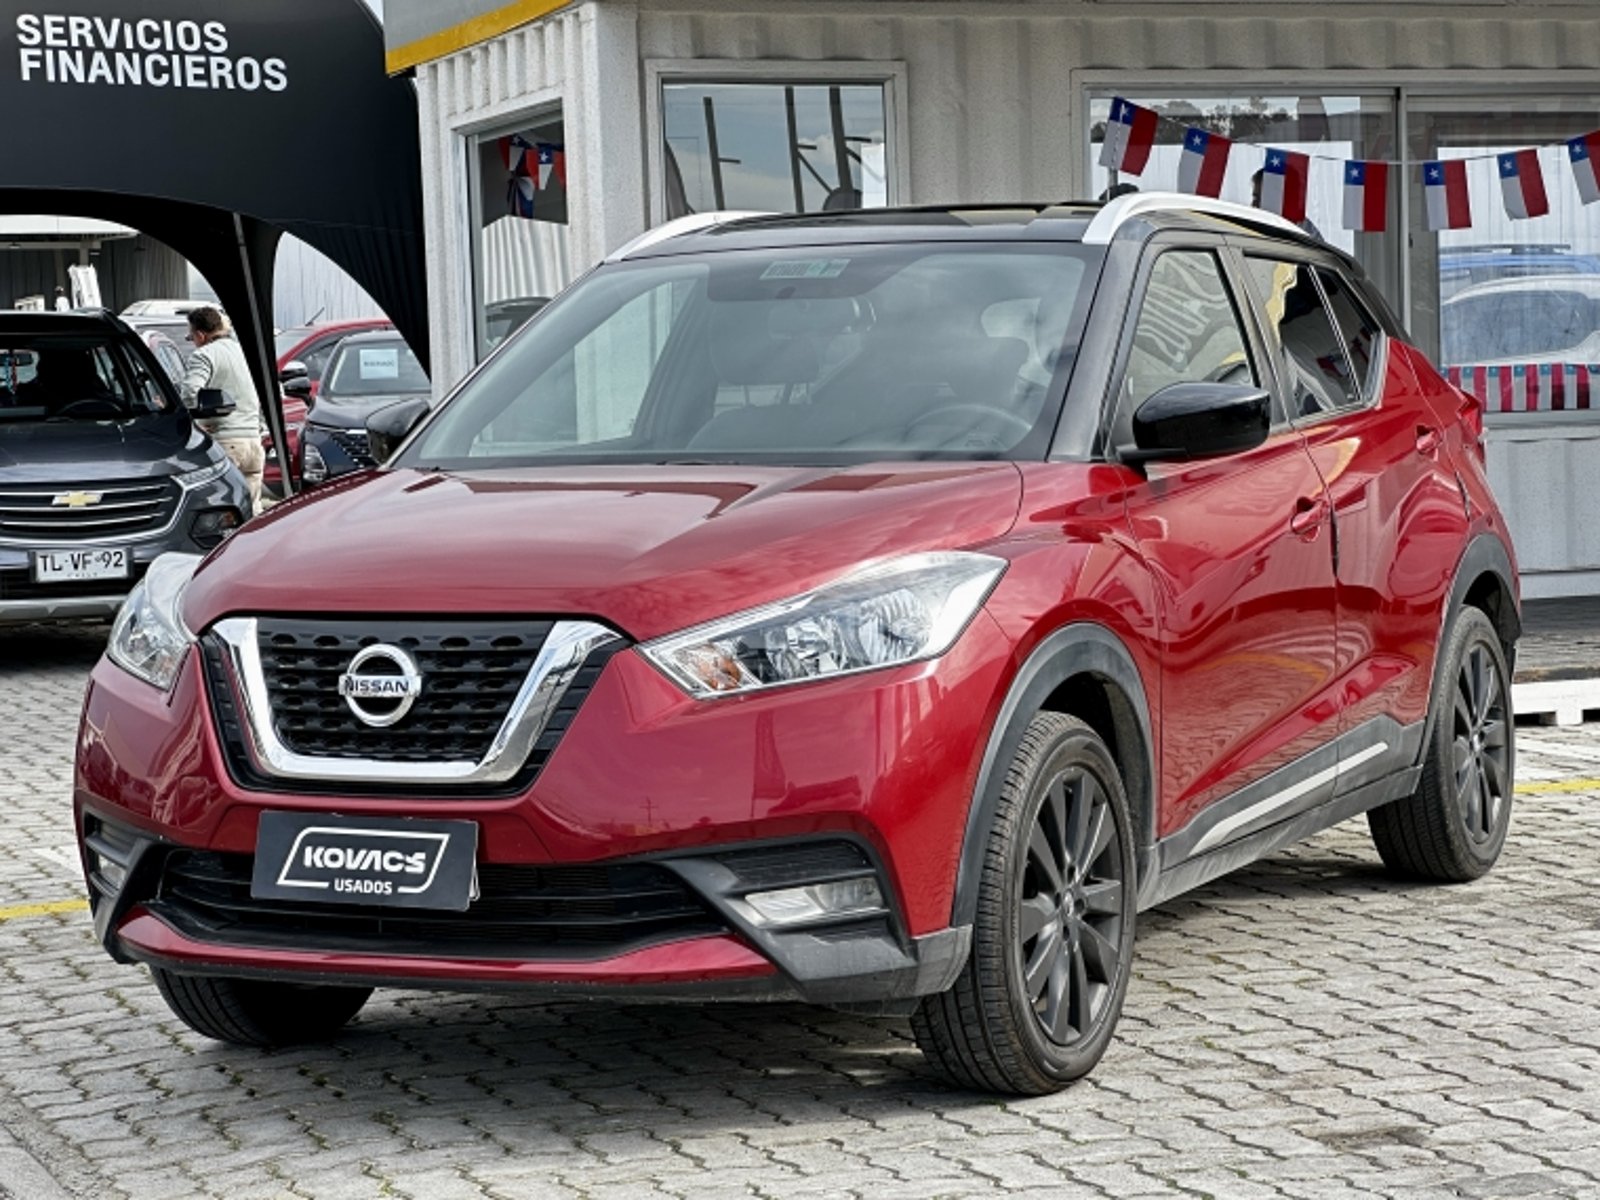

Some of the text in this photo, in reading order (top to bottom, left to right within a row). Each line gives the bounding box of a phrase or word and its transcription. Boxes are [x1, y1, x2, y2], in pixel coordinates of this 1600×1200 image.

[19, 48, 288, 91] FINANCIEROS
[345, 679, 409, 692] NISSAN
[304, 846, 426, 873] KOVACS
[334, 878, 393, 894] USADOS
